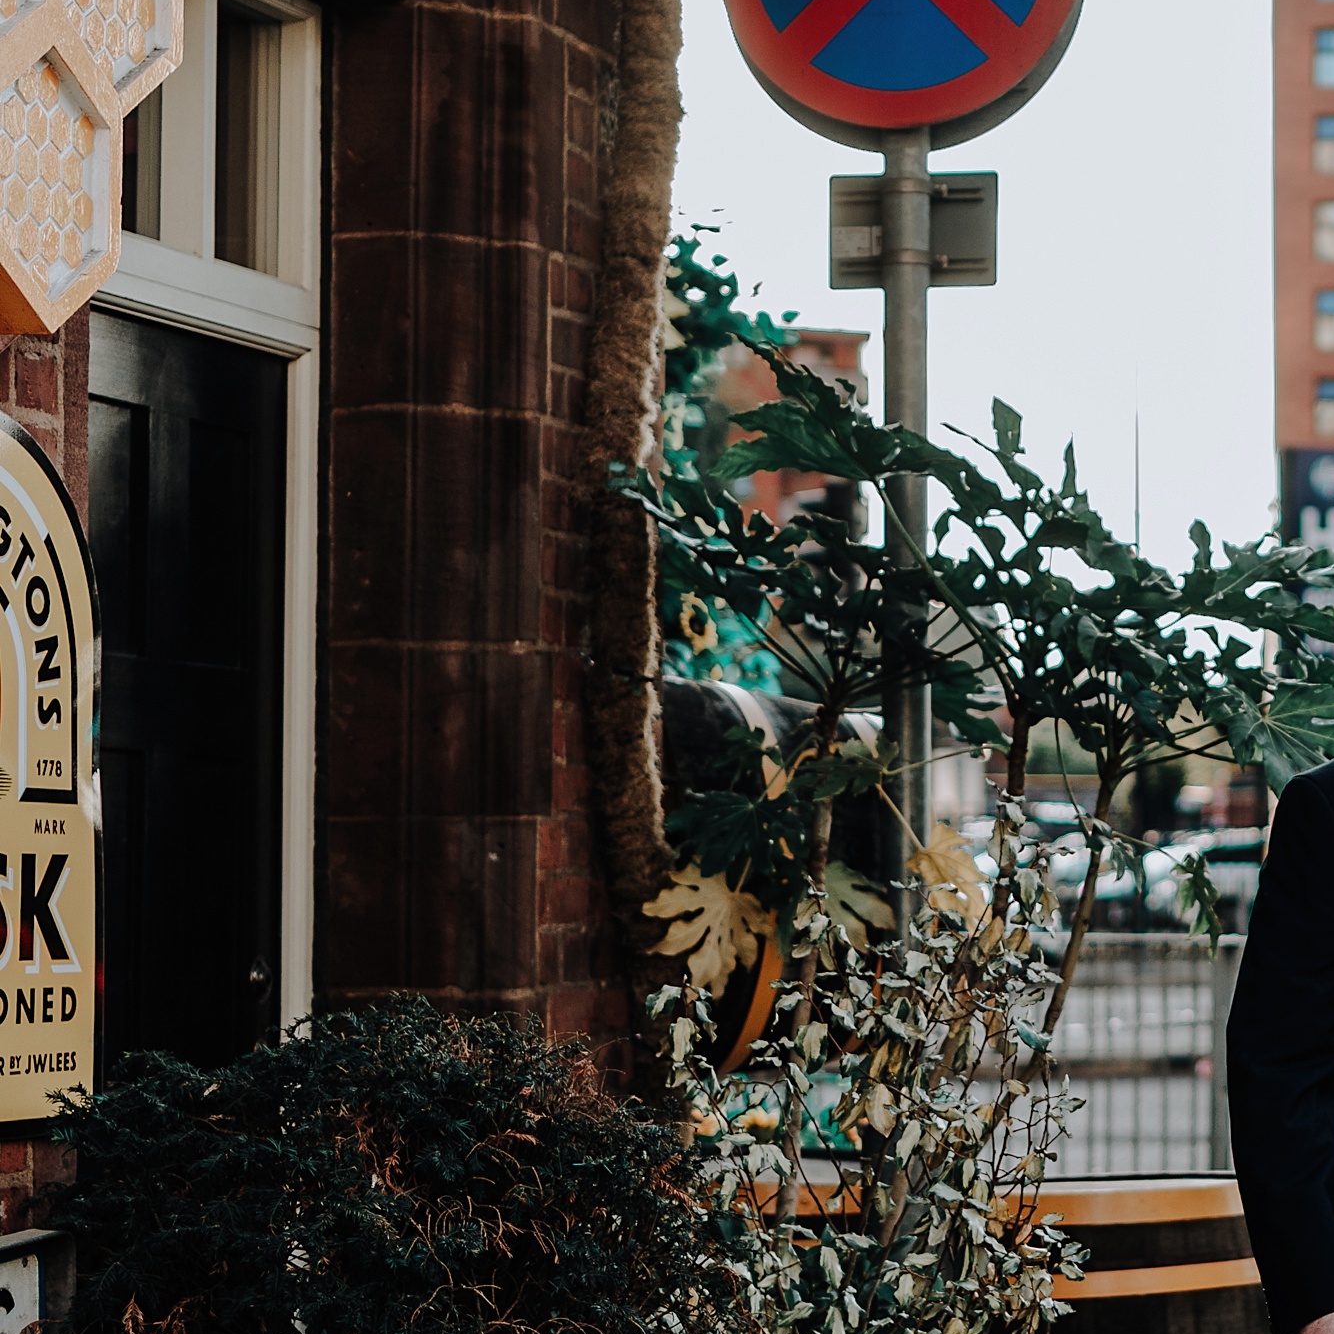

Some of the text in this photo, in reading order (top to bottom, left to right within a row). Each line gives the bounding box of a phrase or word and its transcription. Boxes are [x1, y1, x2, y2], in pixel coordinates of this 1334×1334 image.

[36, 759, 62, 777] 1778
[34, 818, 66, 835] MARK
[9, 1055, 22, 1072] BY
